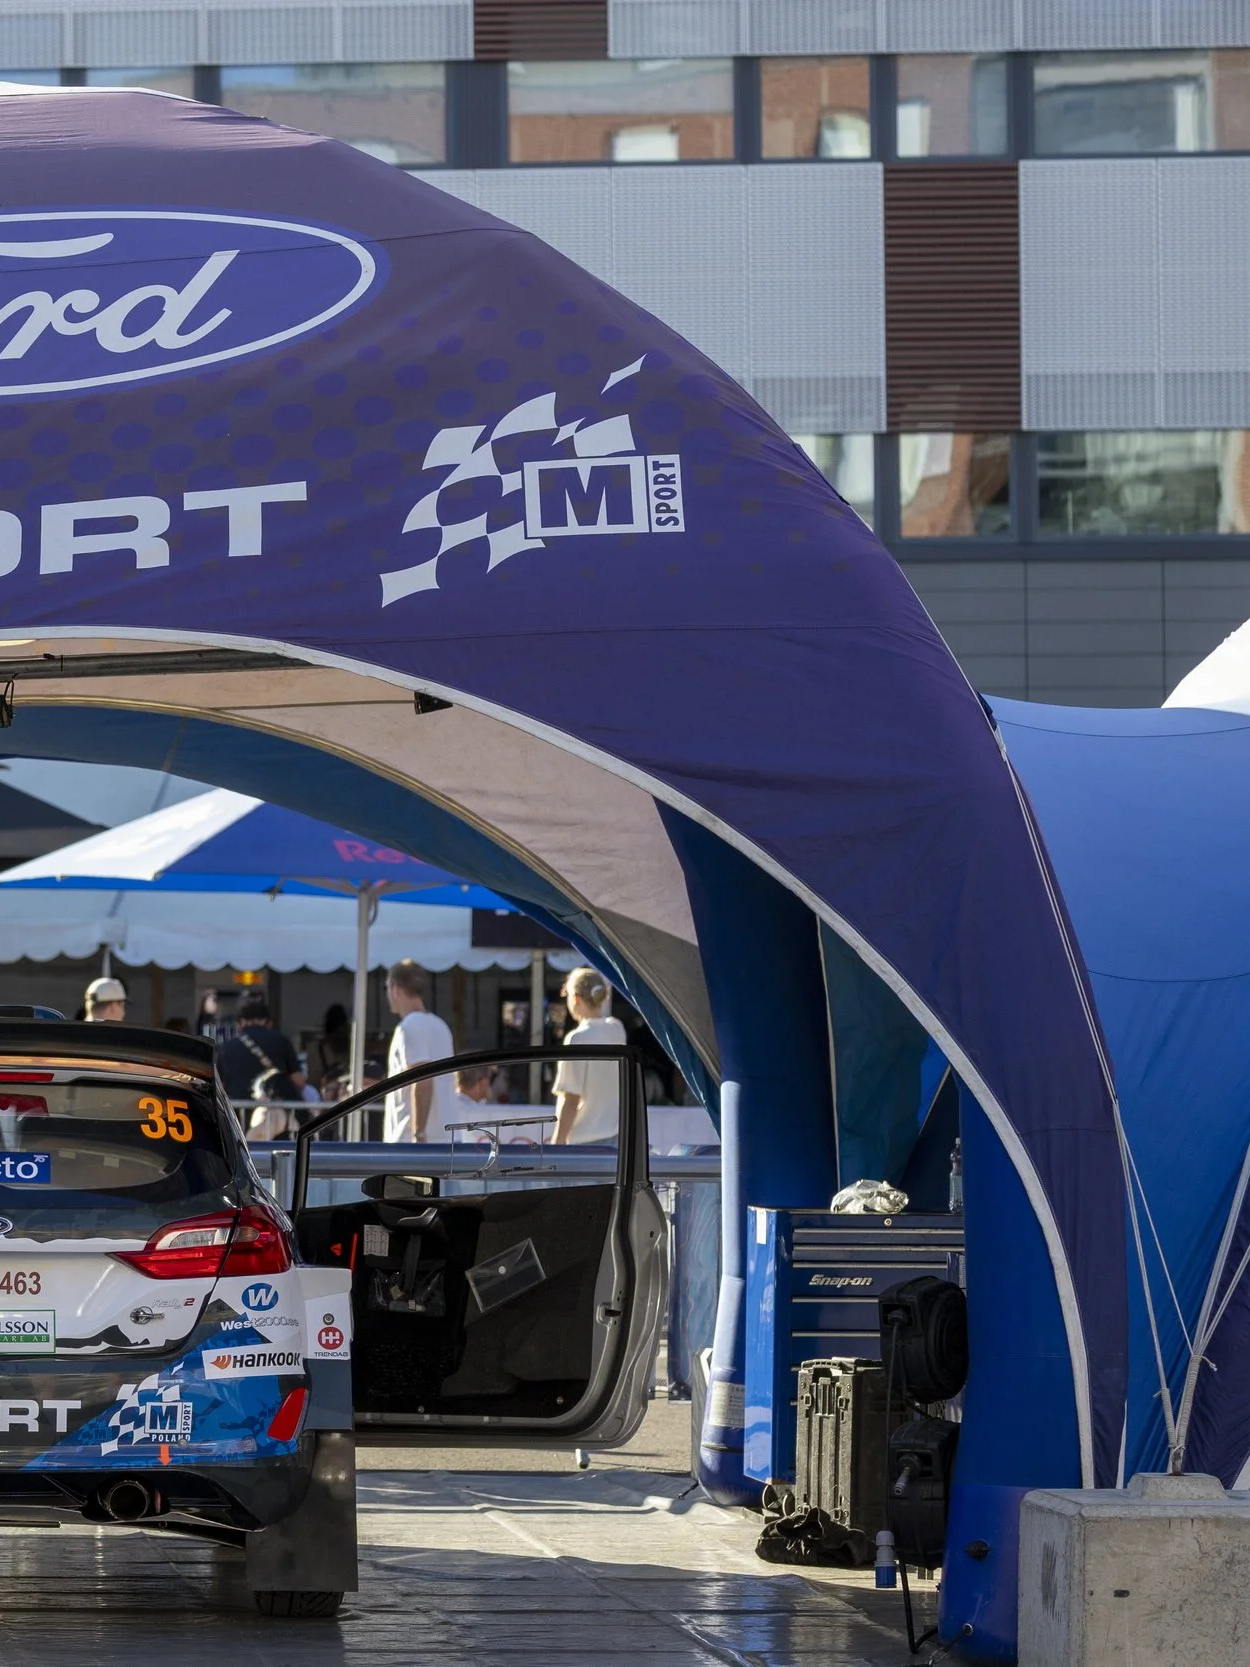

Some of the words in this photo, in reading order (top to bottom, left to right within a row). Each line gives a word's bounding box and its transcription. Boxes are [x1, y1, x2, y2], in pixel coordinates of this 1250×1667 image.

[538, 464, 634, 528] M
[652, 460, 680, 527] SPORT
[138, 1096, 193, 1143] 35
[809, 1274, 872, 1288] Snap-on
[150, 1405, 178, 1430] M
[182, 1404, 191, 1431] SPORT
